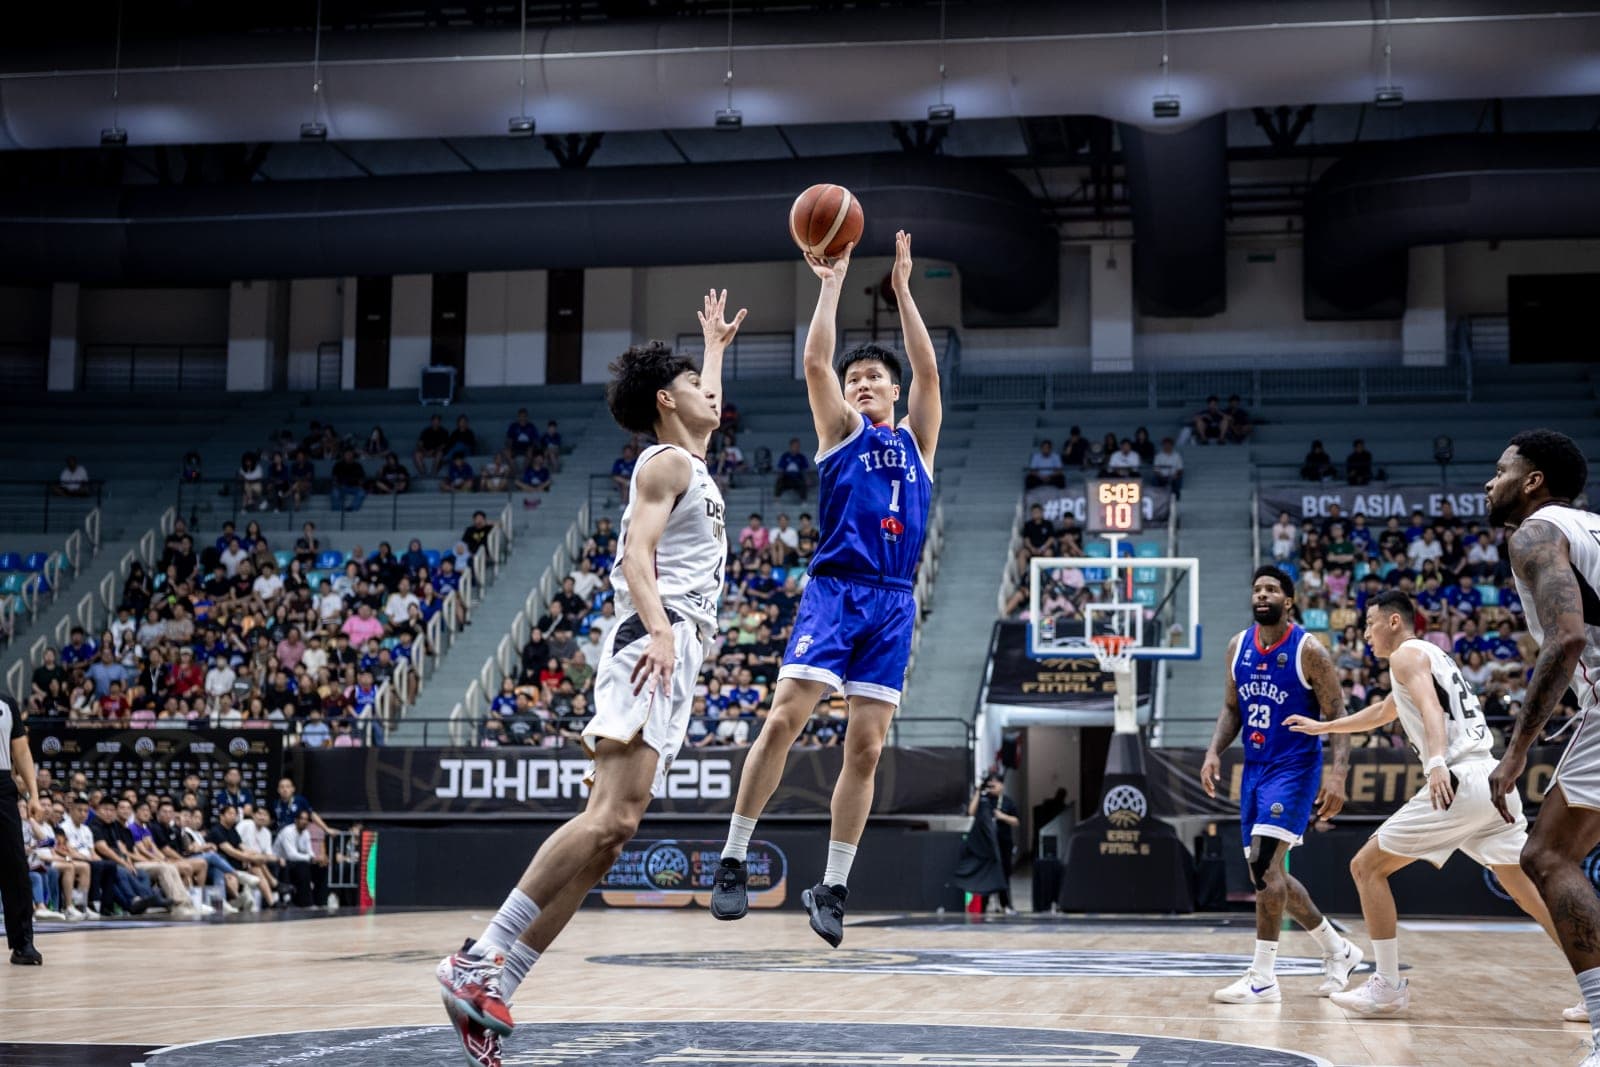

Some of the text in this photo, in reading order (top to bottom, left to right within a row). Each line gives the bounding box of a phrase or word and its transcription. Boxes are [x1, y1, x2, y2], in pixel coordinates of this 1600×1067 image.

[889, 480, 901, 512] 1
[1099, 483, 1140, 504] 6:03
[1105, 504, 1132, 529] 10
[1353, 495, 1407, 517] ASIA
[1429, 494, 1488, 516] EAST
[1022, 682, 1095, 694] FINAL
[1037, 671, 1102, 683] EAST
[1238, 681, 1289, 704] TIGERS
[1247, 703, 1271, 729] 23
[435, 758, 732, 801] JOHOR 26
